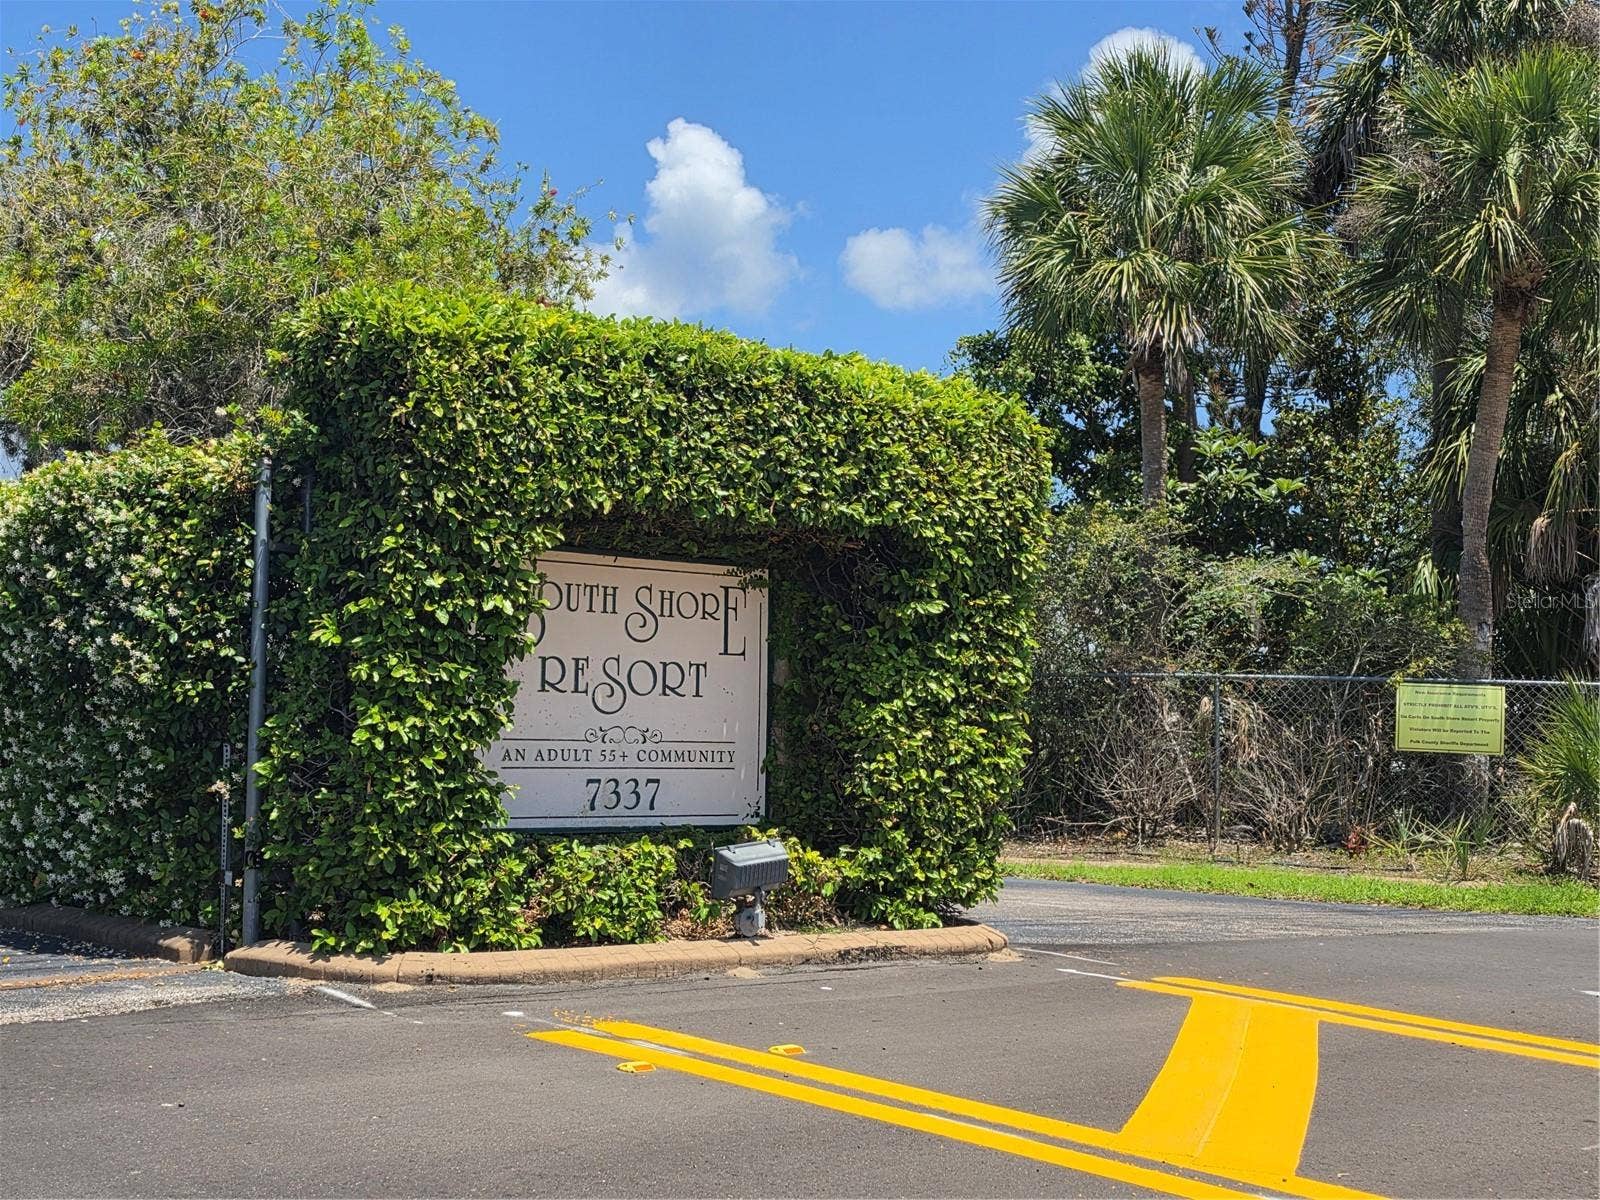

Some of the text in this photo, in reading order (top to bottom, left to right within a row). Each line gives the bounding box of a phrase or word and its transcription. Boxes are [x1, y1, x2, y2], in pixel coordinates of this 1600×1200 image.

[625, 583, 746, 661] SHORE
[537, 654, 708, 715] RESORT
[501, 747, 736, 763] AN ADULT 55+ COMMUNITY
[585, 778, 661, 811] 7337
